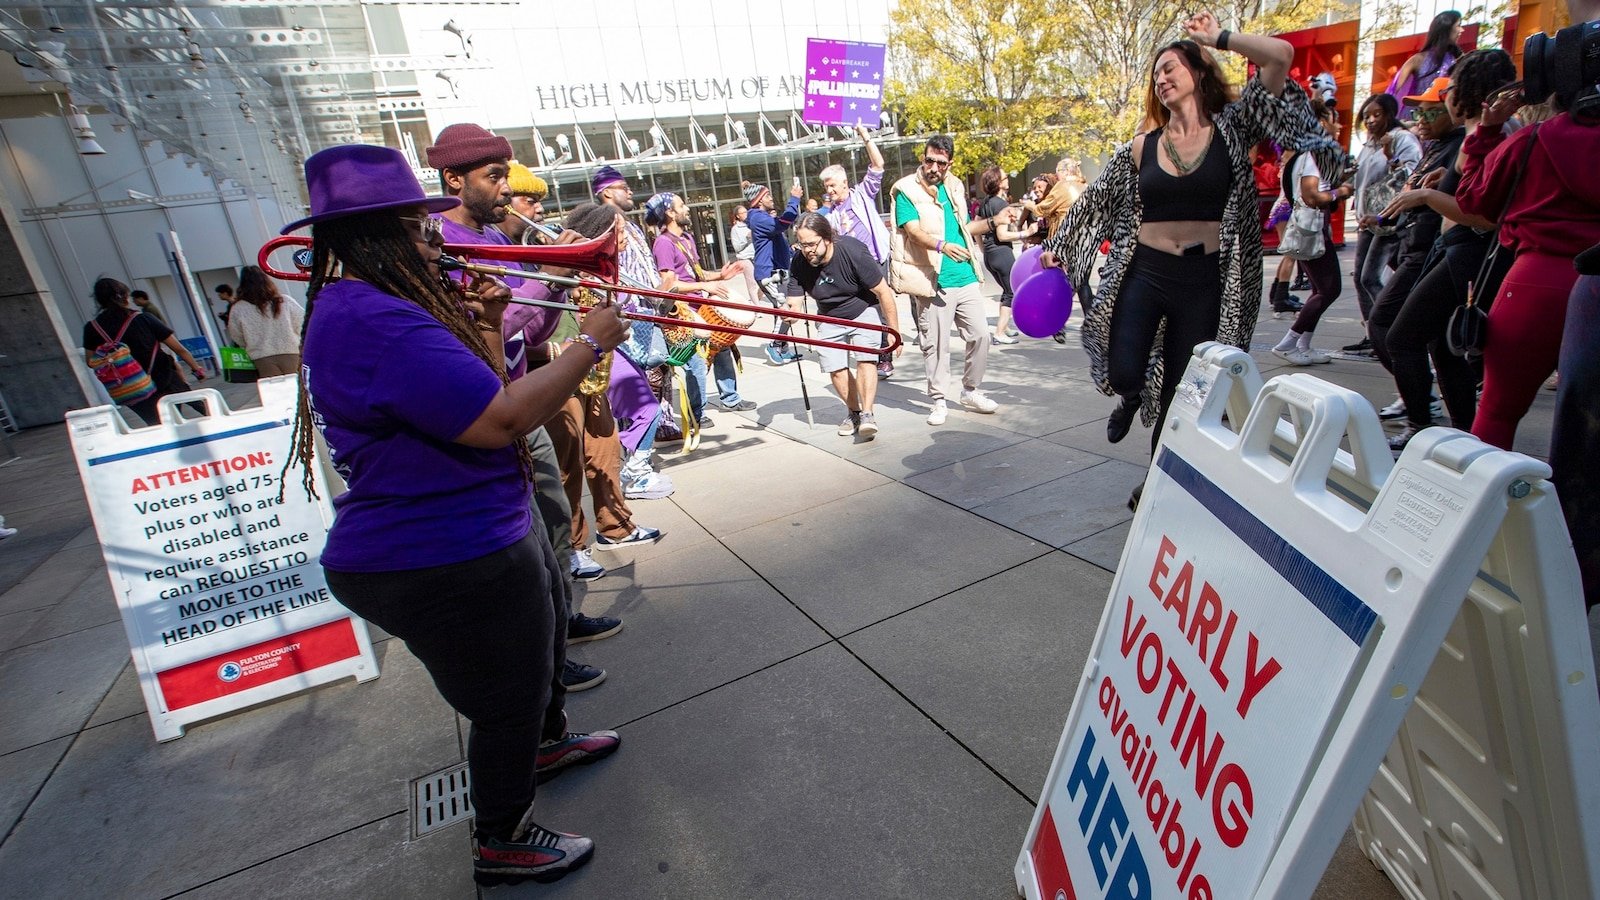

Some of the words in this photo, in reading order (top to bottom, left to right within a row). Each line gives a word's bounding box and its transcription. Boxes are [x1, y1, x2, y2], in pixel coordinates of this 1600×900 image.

[831, 58, 869, 67] DAYBREAKER
[536, 82, 611, 110] HIGH
[620, 77, 733, 106] MUSEUM
[741, 75, 769, 99] OF
[777, 75, 806, 98] AR
[131, 451, 273, 495] ATTENTION:
[134, 493, 198, 515] Voters
[202, 478, 247, 501] aged
[144, 518, 185, 540] plus
[189, 512, 209, 525] or
[213, 502, 252, 520] who
[257, 495, 285, 509] are
[162, 524, 243, 554] disabled
[247, 514, 281, 533] and
[145, 555, 214, 582] require
[218, 531, 309, 563] assistance
[160, 584, 193, 600] can
[196, 558, 280, 591] REQUEST
[283, 551, 308, 567] TO
[162, 620, 217, 645] HEAD
[221, 611, 248, 628] OF
[248, 599, 287, 620] THE
[289, 588, 330, 609] LINE
[179, 592, 237, 618] MOVE
[237, 585, 264, 600] TO
[266, 574, 303, 594] THE
[1148, 534, 1283, 720] EARLY
[240, 652, 271, 666] FULTON
[270, 643, 301, 657] COUNTY
[1120, 595, 1253, 848] VOTING
[1067, 725, 1152, 900] HER
